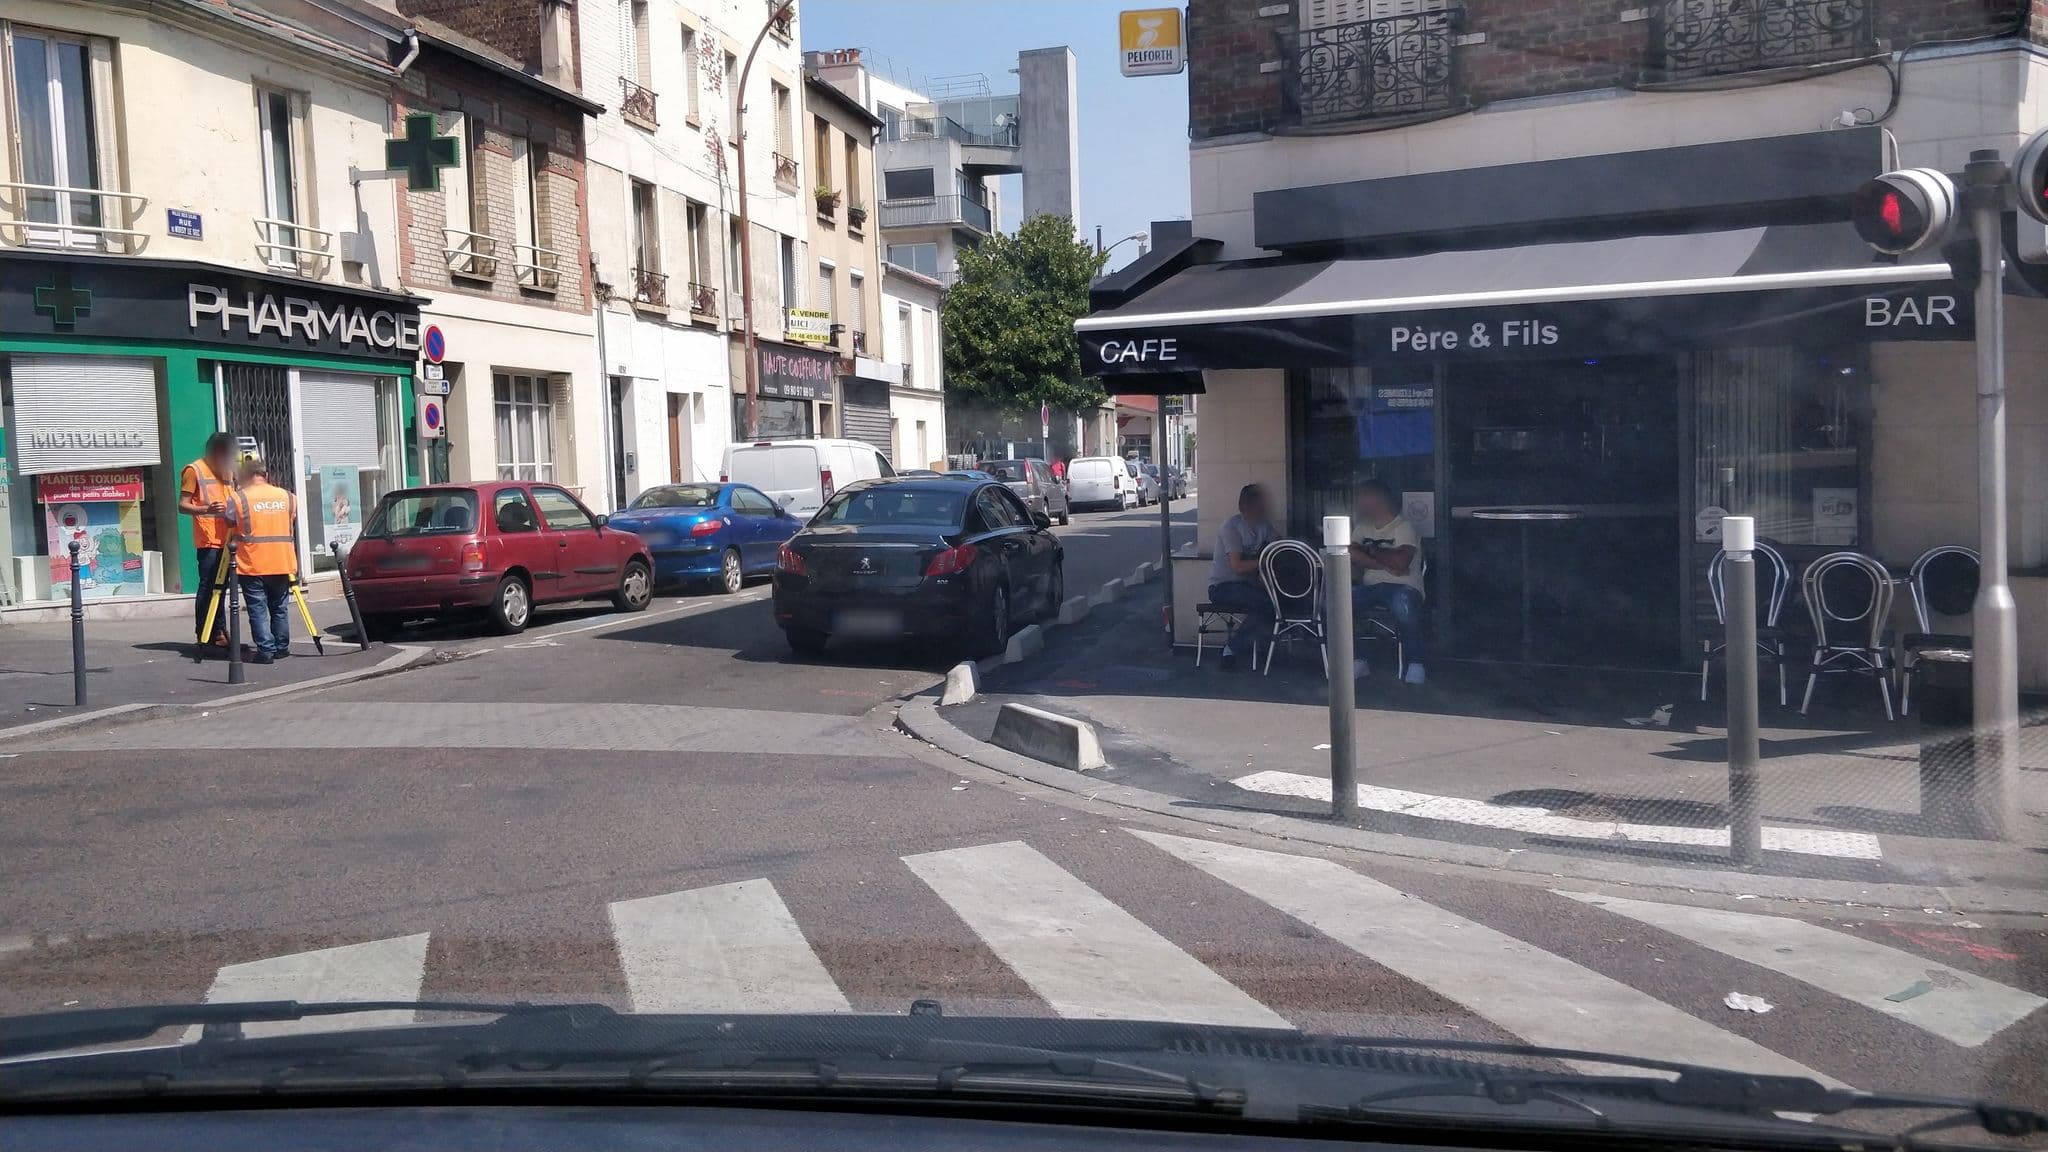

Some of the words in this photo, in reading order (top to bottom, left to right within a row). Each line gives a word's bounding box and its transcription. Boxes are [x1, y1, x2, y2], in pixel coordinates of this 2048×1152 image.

[1128, 50, 1172, 63] PELFORTH
[178, 218, 192, 227] RUE
[188, 283, 421, 351] PHARMACIE
[799, 311, 829, 319] VENDRE
[1865, 295, 1956, 327] BAR
[1391, 326, 1458, 351] Père
[1469, 322, 1491, 348] &
[1503, 320, 1559, 346] Fils
[1100, 338, 1177, 364] CAFE
[763, 351, 787, 376] HAUTE
[788, 357, 822, 381] COIFFURE
[32, 427, 143, 448] MUTUELLES
[40, 475, 86, 485] PLANTES
[90, 474, 140, 484] TOXIQUES
[82, 491, 100, 500] petits
